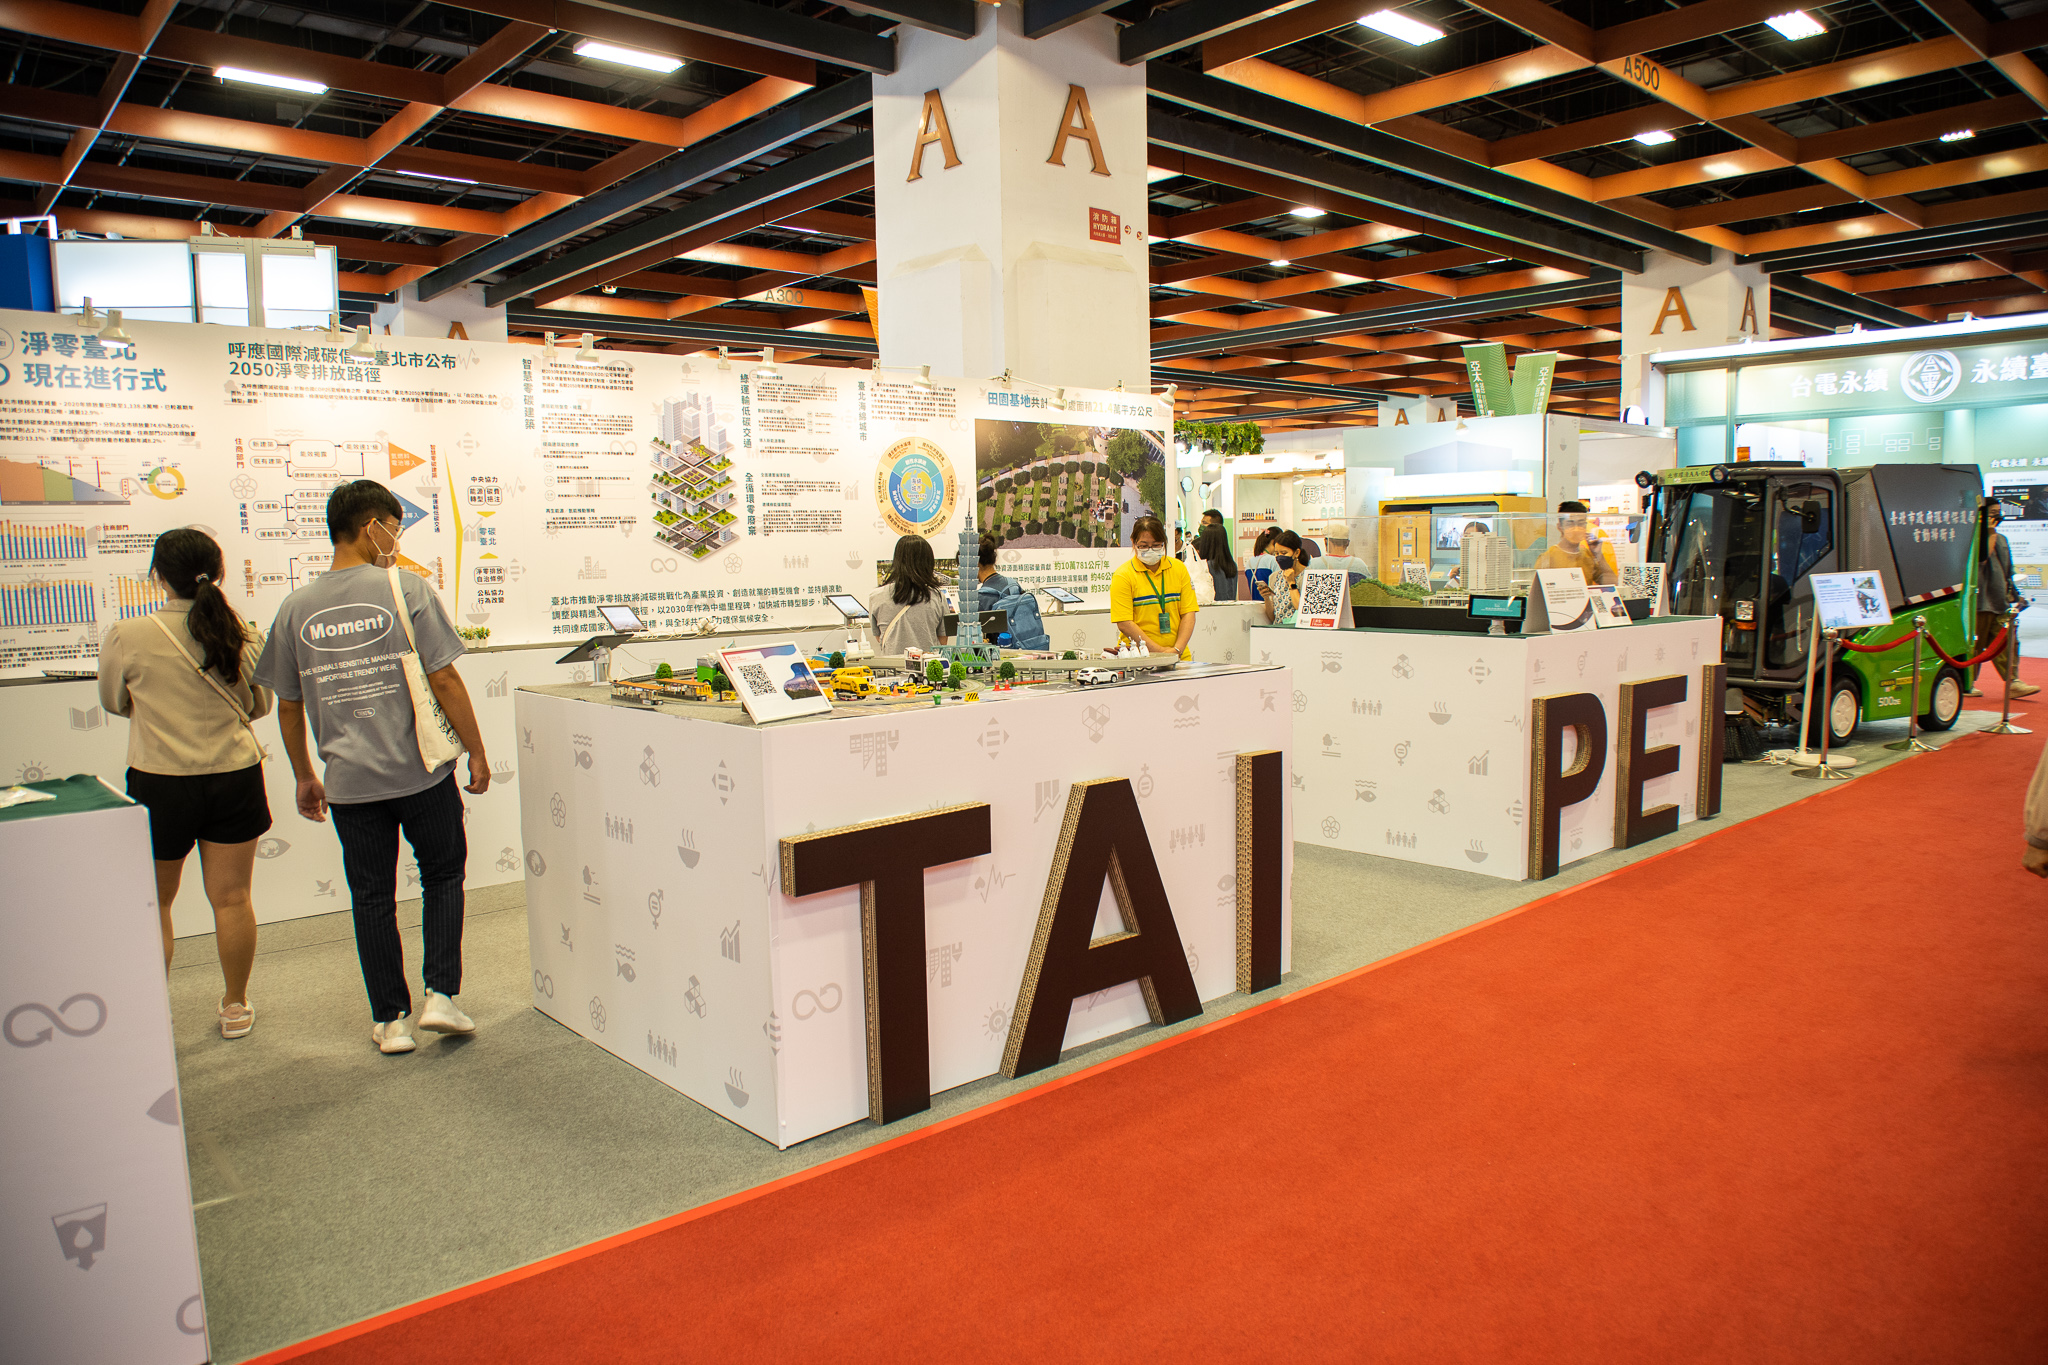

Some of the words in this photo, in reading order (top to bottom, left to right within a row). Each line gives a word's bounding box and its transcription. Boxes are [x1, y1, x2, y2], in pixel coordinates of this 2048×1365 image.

[1623, 56, 1661, 92] A500
[906, 88, 962, 183] A
[1045, 83, 1112, 177] A
[1092, 223, 1117, 233] HYDRANT
[765, 288, 804, 304] A300
[1650, 286, 1697, 335] A
[1739, 286, 1760, 335] A
[228, 342, 456, 369] 呼應國際減碳倡臺北市公布
[23, 363, 167, 392] 現在進行式
[229, 361, 382, 383] 2050淨零排放路徑
[1790, 368, 1888, 398] 台電永續
[522, 358, 535, 430] 智慧零碳建築
[309, 614, 384, 641] Moment
[300, 669, 312, 678] THE
[339, 658, 370, 669] SENSITIVE
[354, 666, 379, 678] TRENDY
